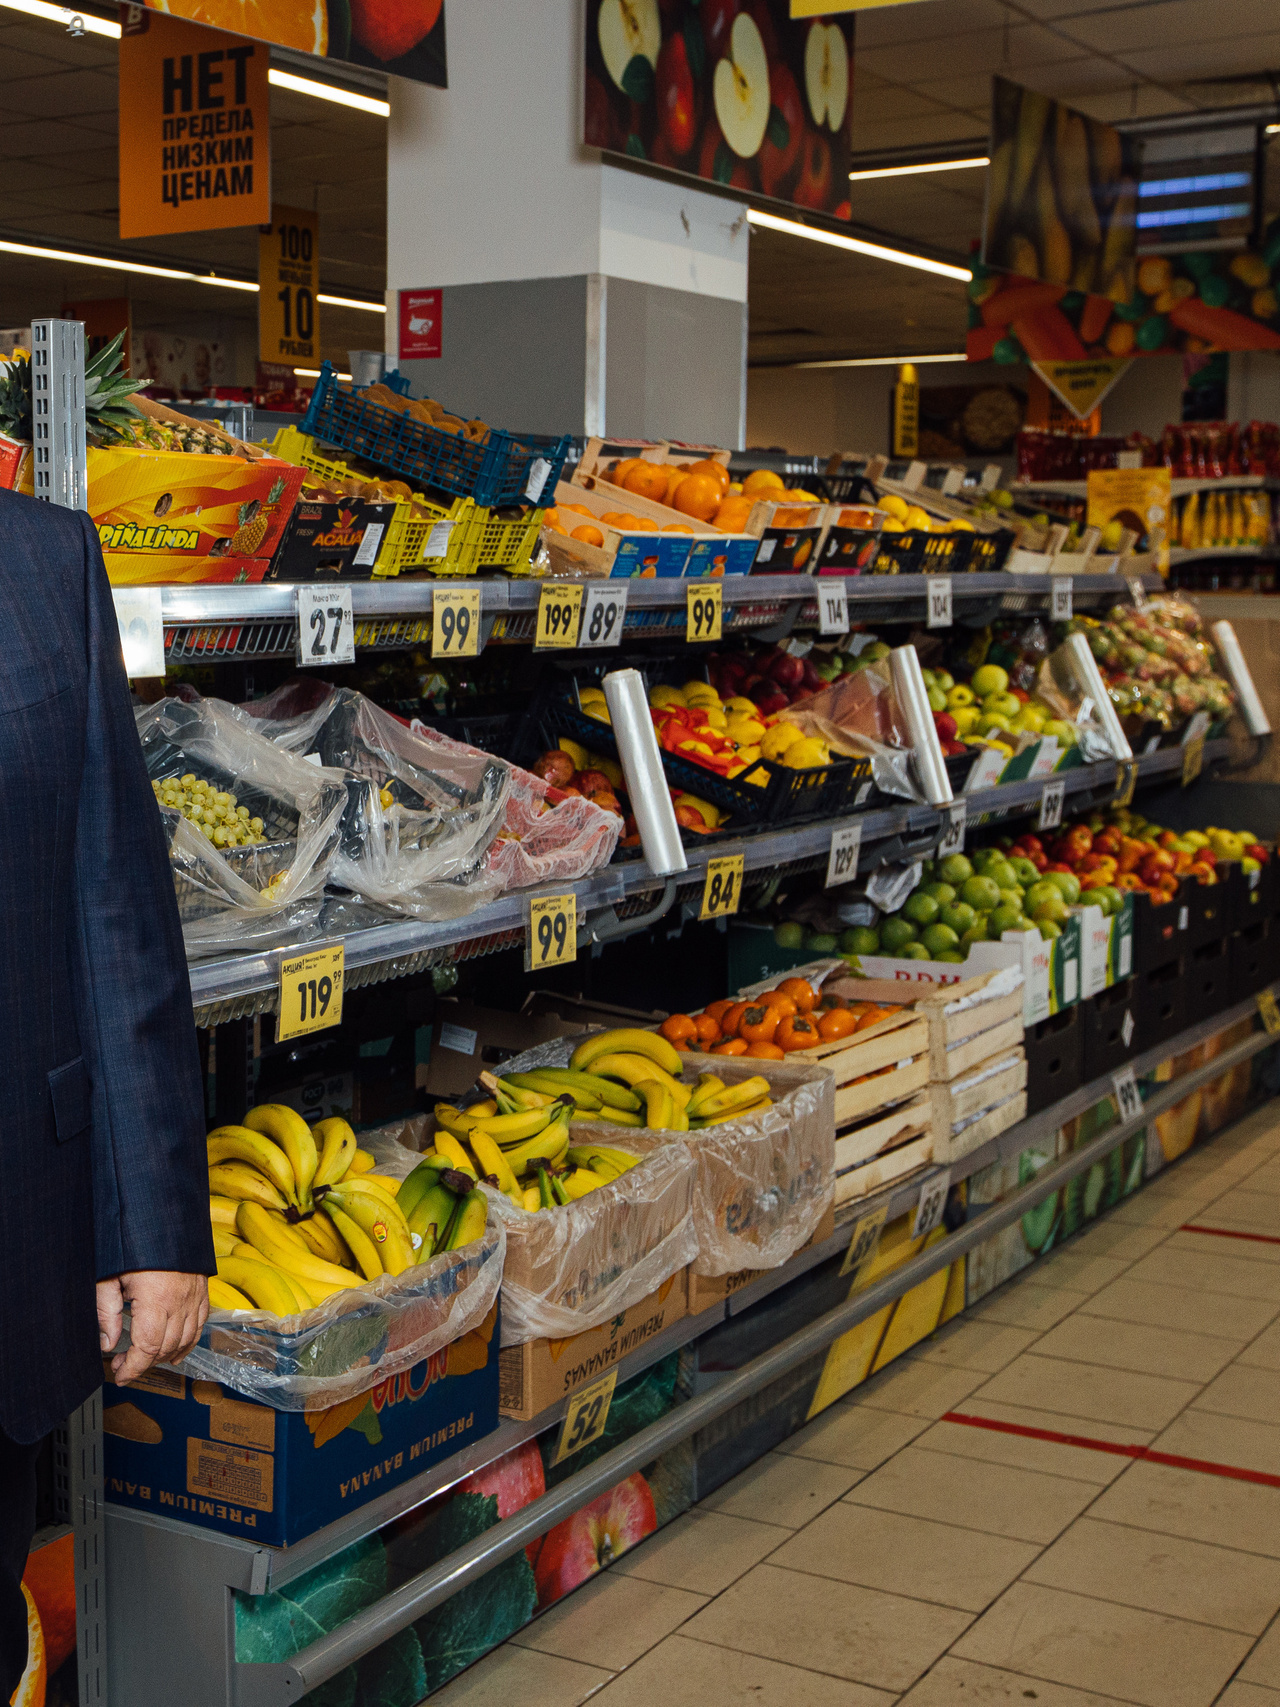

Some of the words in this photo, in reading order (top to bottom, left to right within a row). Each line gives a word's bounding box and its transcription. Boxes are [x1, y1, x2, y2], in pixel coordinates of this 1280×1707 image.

[163, 45, 254, 114] НЕТ
[163, 108, 254, 141] ПРЕДЕЛА
[163, 136, 253, 171] НИЗКИМ
[162, 165, 253, 208] ЦЕНАМ
[278, 223, 312, 262] 100
[278, 284, 314, 341] 10
[310, 607, 343, 656] 27
[441, 607, 470, 651] 99
[545, 603, 572, 635] 199
[588, 602, 617, 641] 89
[693, 598, 714, 636] 99
[834, 846, 854, 876] 129
[708, 871, 734, 912] 84
[538, 912, 567, 961] 99
[283, 959, 305, 975] АКЦИЯ!
[298, 976, 332, 1022] 119
[333, 970, 342, 981] 99
[620, 1310, 665, 1352] PREMIUM
[563, 1343, 618, 1391] BANANAS
[410, 1412, 474, 1461] PREMIUM
[567, 1394, 603, 1450] 52
[339, 1451, 404, 1498] BANANA
[159, 1490, 257, 1527] PREMIUM
